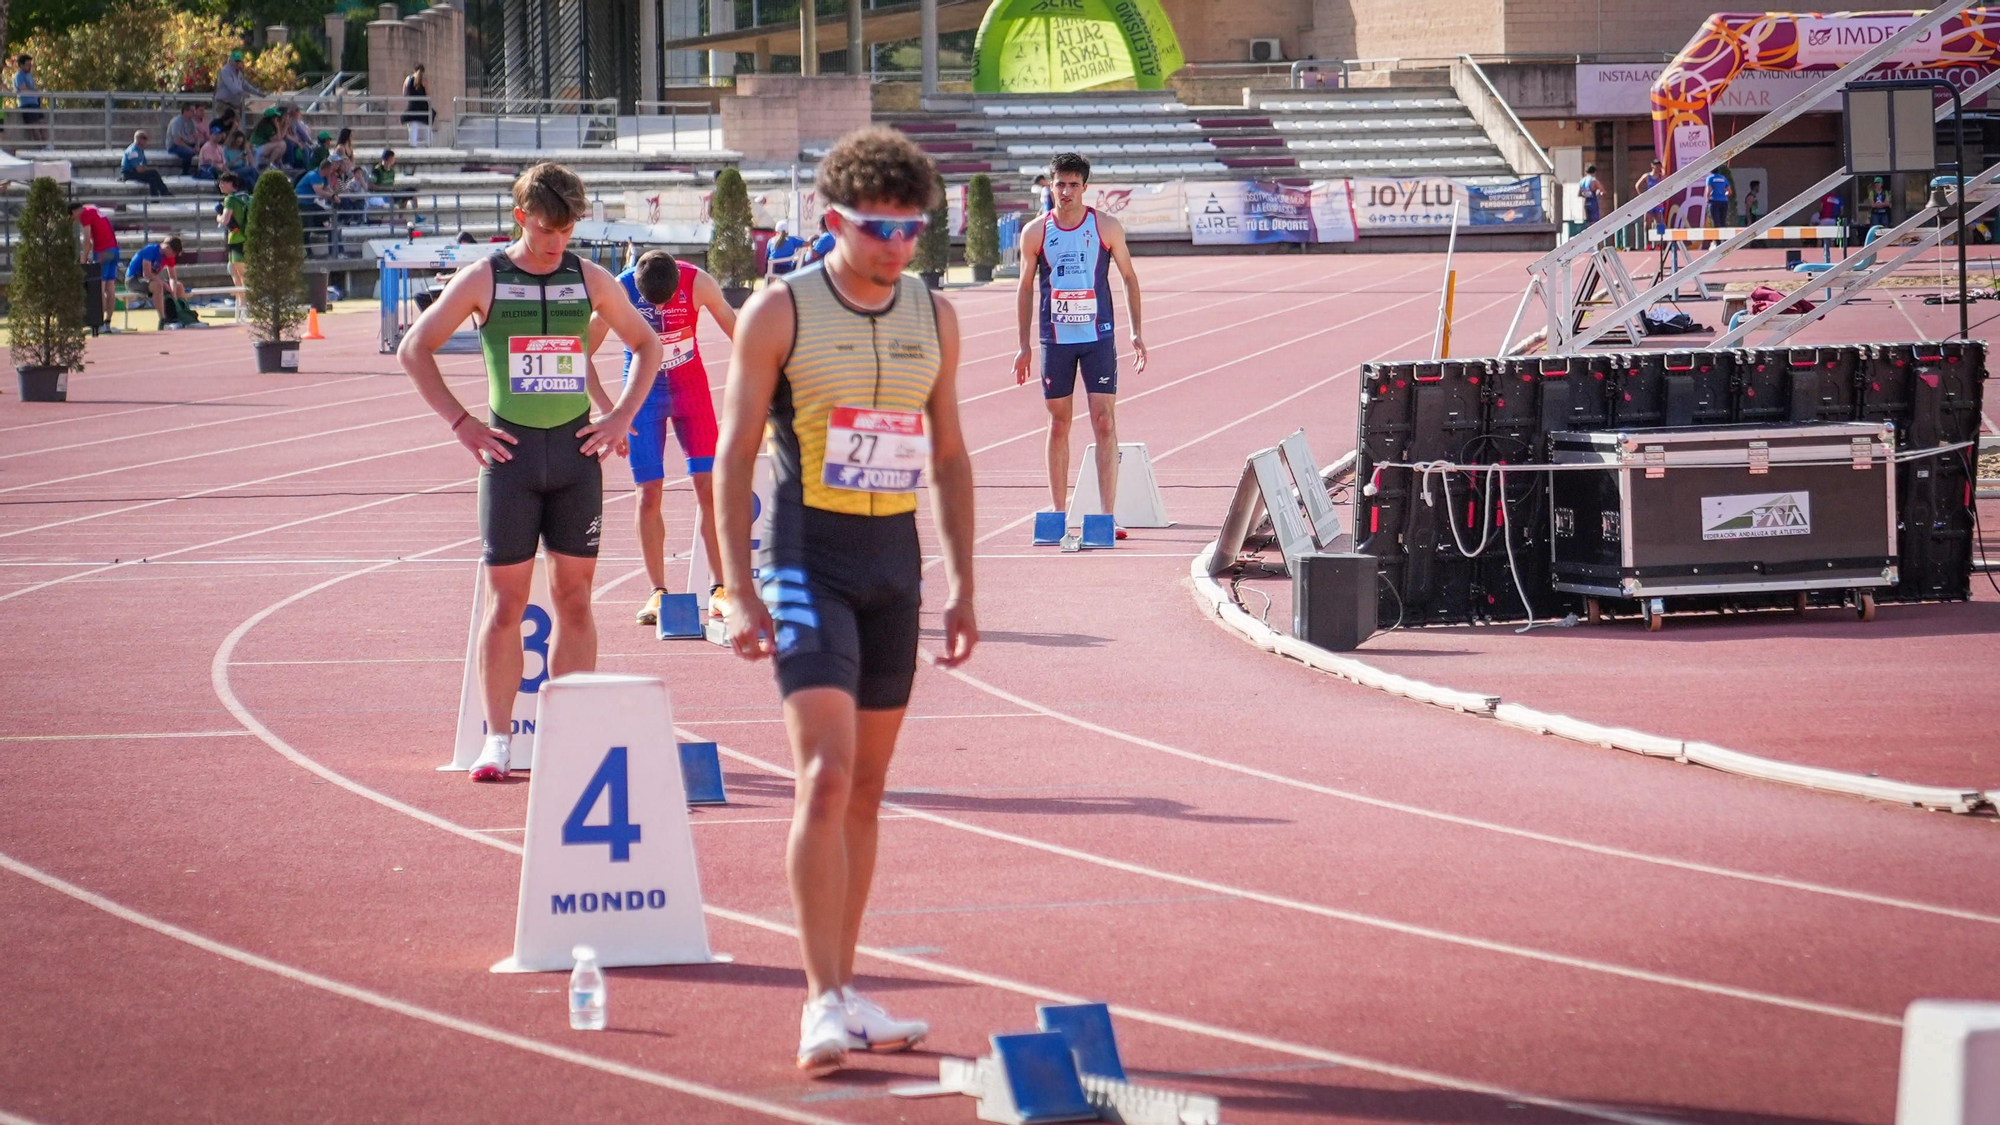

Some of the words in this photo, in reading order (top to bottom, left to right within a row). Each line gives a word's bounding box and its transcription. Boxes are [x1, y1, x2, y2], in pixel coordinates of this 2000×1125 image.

[1115, 2, 1157, 76] ATLETISMO
[1598, 71, 1662, 82] INSTALAC
[1680, 141, 1708, 149] IMDECO
[1196, 216, 1240, 229] AIRE
[1258, 221, 1270, 231] EL
[1272, 219, 1310, 231] DEPORTE
[1056, 300, 1069, 313] 24
[501, 310, 538, 319] ATLETISMO
[522, 354, 543, 376] 31
[660, 354, 688, 371] oma
[847, 433, 879, 465] 27
[561, 746, 642, 863] 4
[550, 889, 667, 916] MONDO
